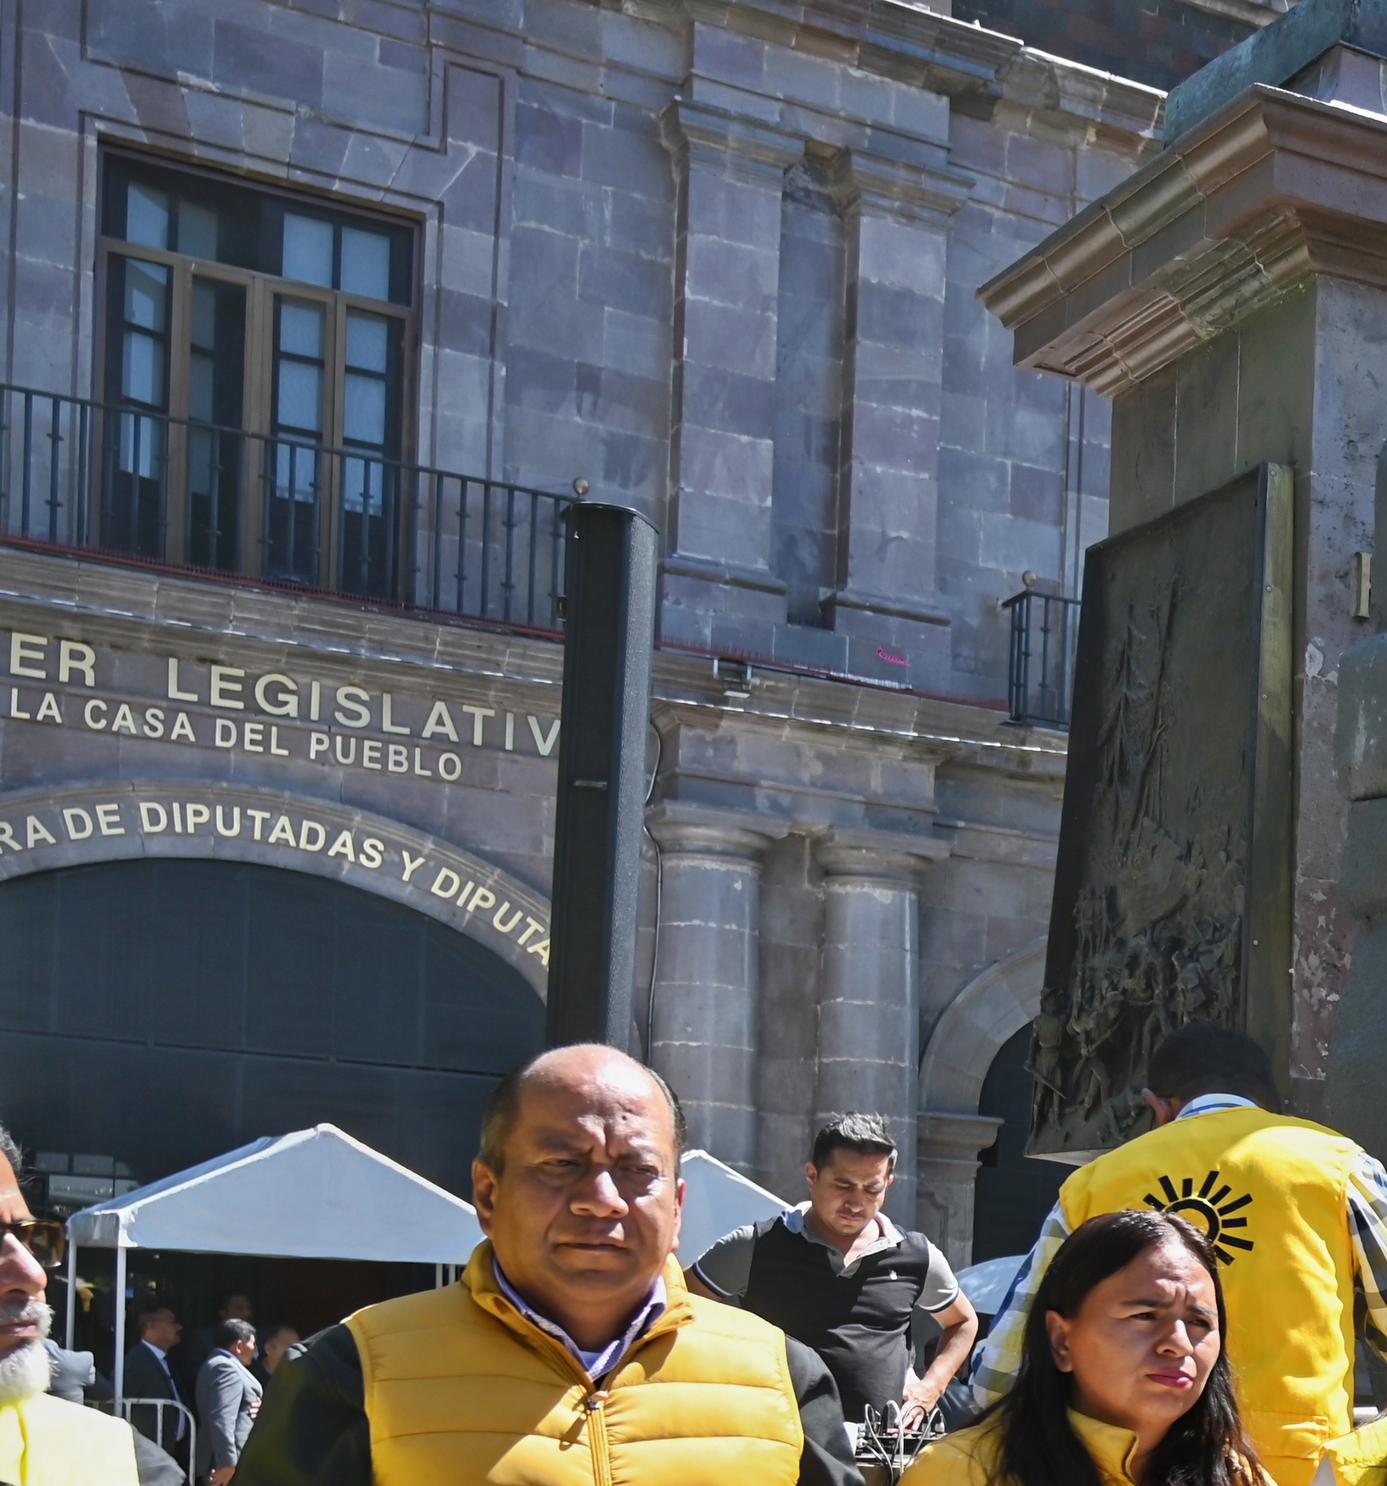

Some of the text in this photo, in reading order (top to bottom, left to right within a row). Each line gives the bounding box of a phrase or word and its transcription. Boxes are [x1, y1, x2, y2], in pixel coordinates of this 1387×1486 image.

[10, 688, 462, 781] LA CASA DEL PUEBLO
[167, 656, 561, 757] LEGISLATIV
[63, 803, 125, 840] DE
[140, 801, 385, 869] DIPUTADAS
[402, 850, 427, 882] Y
[430, 866, 550, 967] DIPUTA
